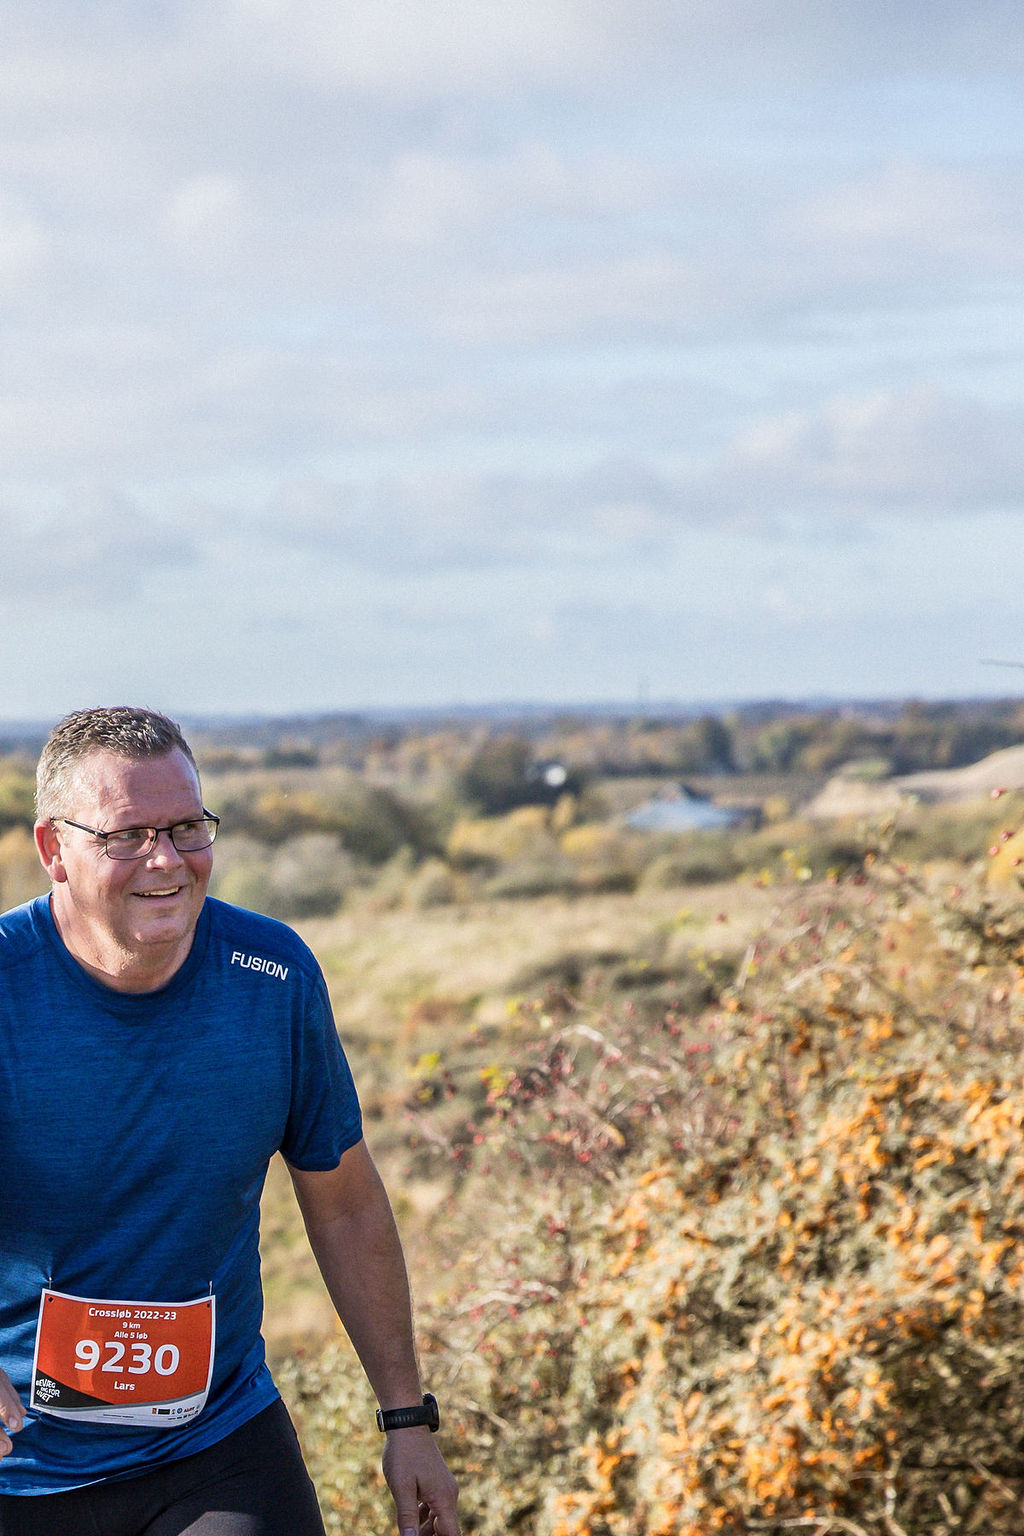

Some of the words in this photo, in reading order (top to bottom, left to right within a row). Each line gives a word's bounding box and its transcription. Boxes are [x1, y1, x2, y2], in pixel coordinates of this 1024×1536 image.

[231, 951, 289, 981] FUSION
[88, 1307, 131, 1319] Crossløb
[133, 1310, 177, 1320] 2022-23
[122, 1321, 128, 1329] 9
[114, 1331, 129, 1339] Alle
[74, 1339, 180, 1376] 9230
[113, 1381, 136, 1391] Lars
